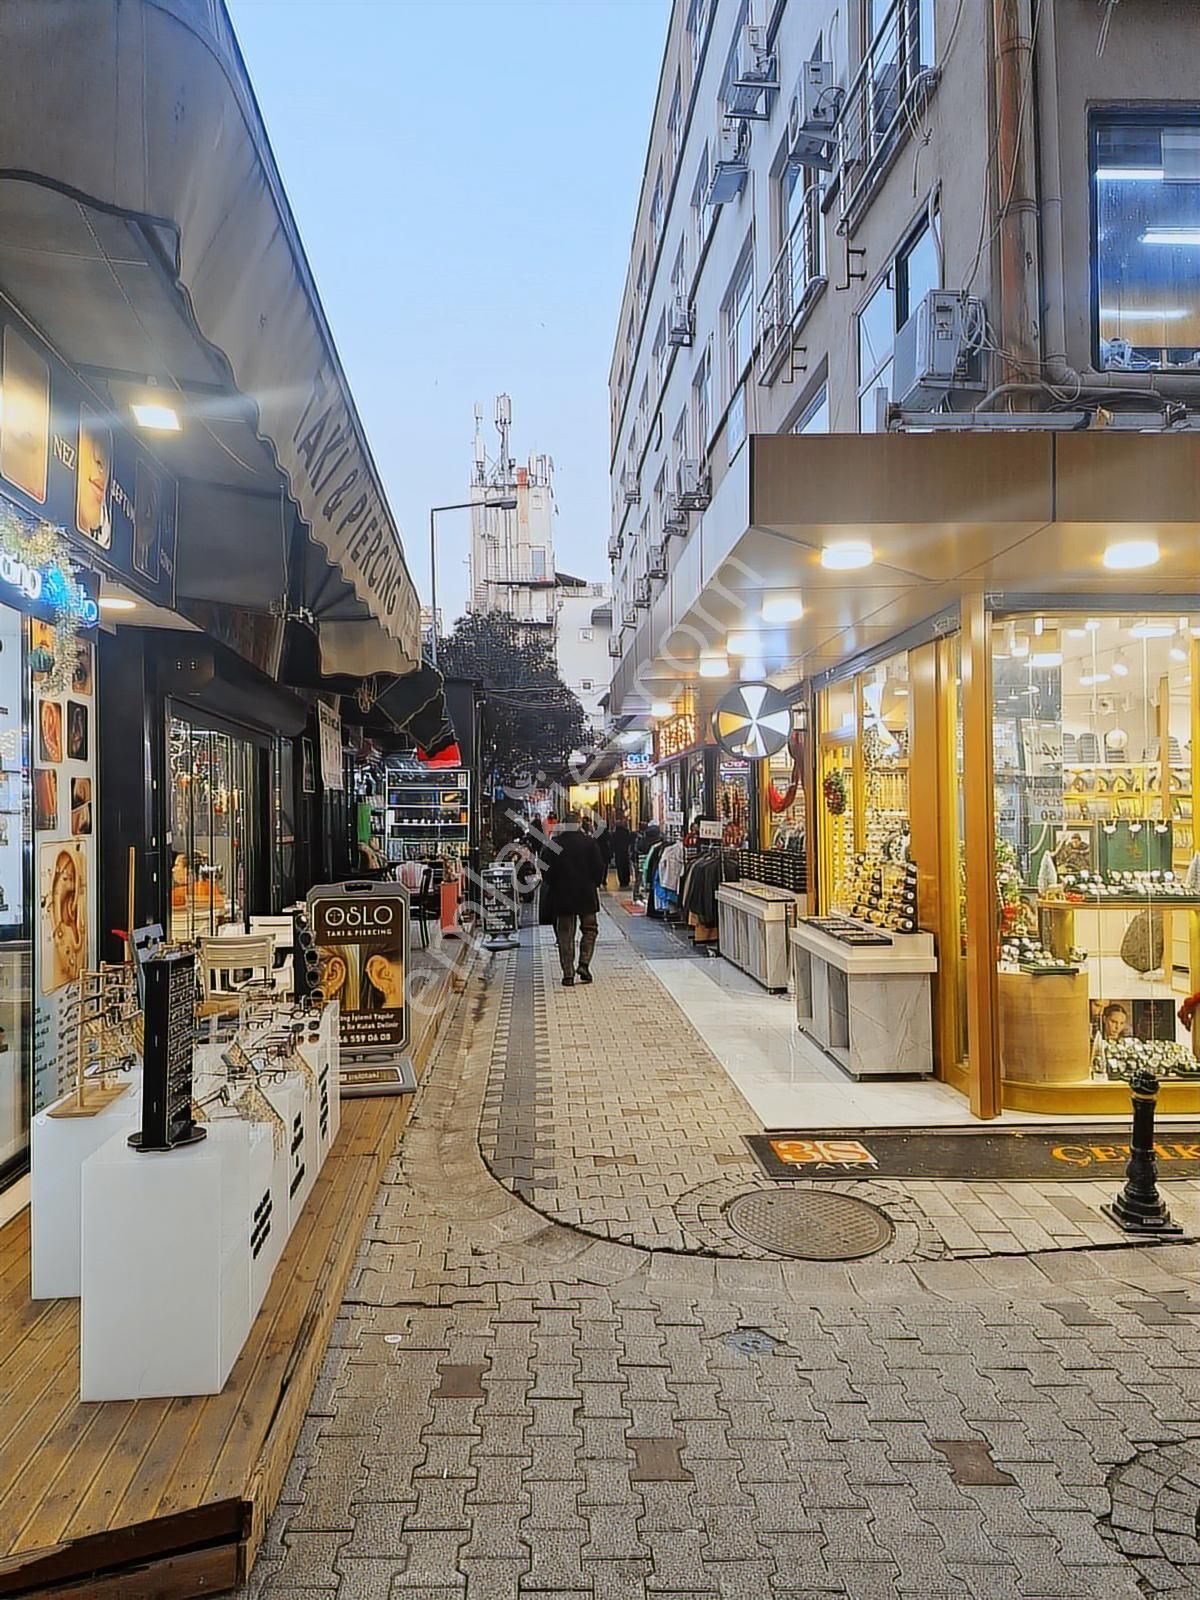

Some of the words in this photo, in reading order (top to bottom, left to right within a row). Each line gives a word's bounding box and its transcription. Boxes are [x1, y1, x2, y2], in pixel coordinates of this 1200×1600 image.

[322, 469, 359, 522] &
[336, 492, 402, 616] PIERCING
[325, 905, 393, 927] OSLO
[354, 928, 393, 936] PIERCING
[786, 1161, 880, 1171] TAKI
